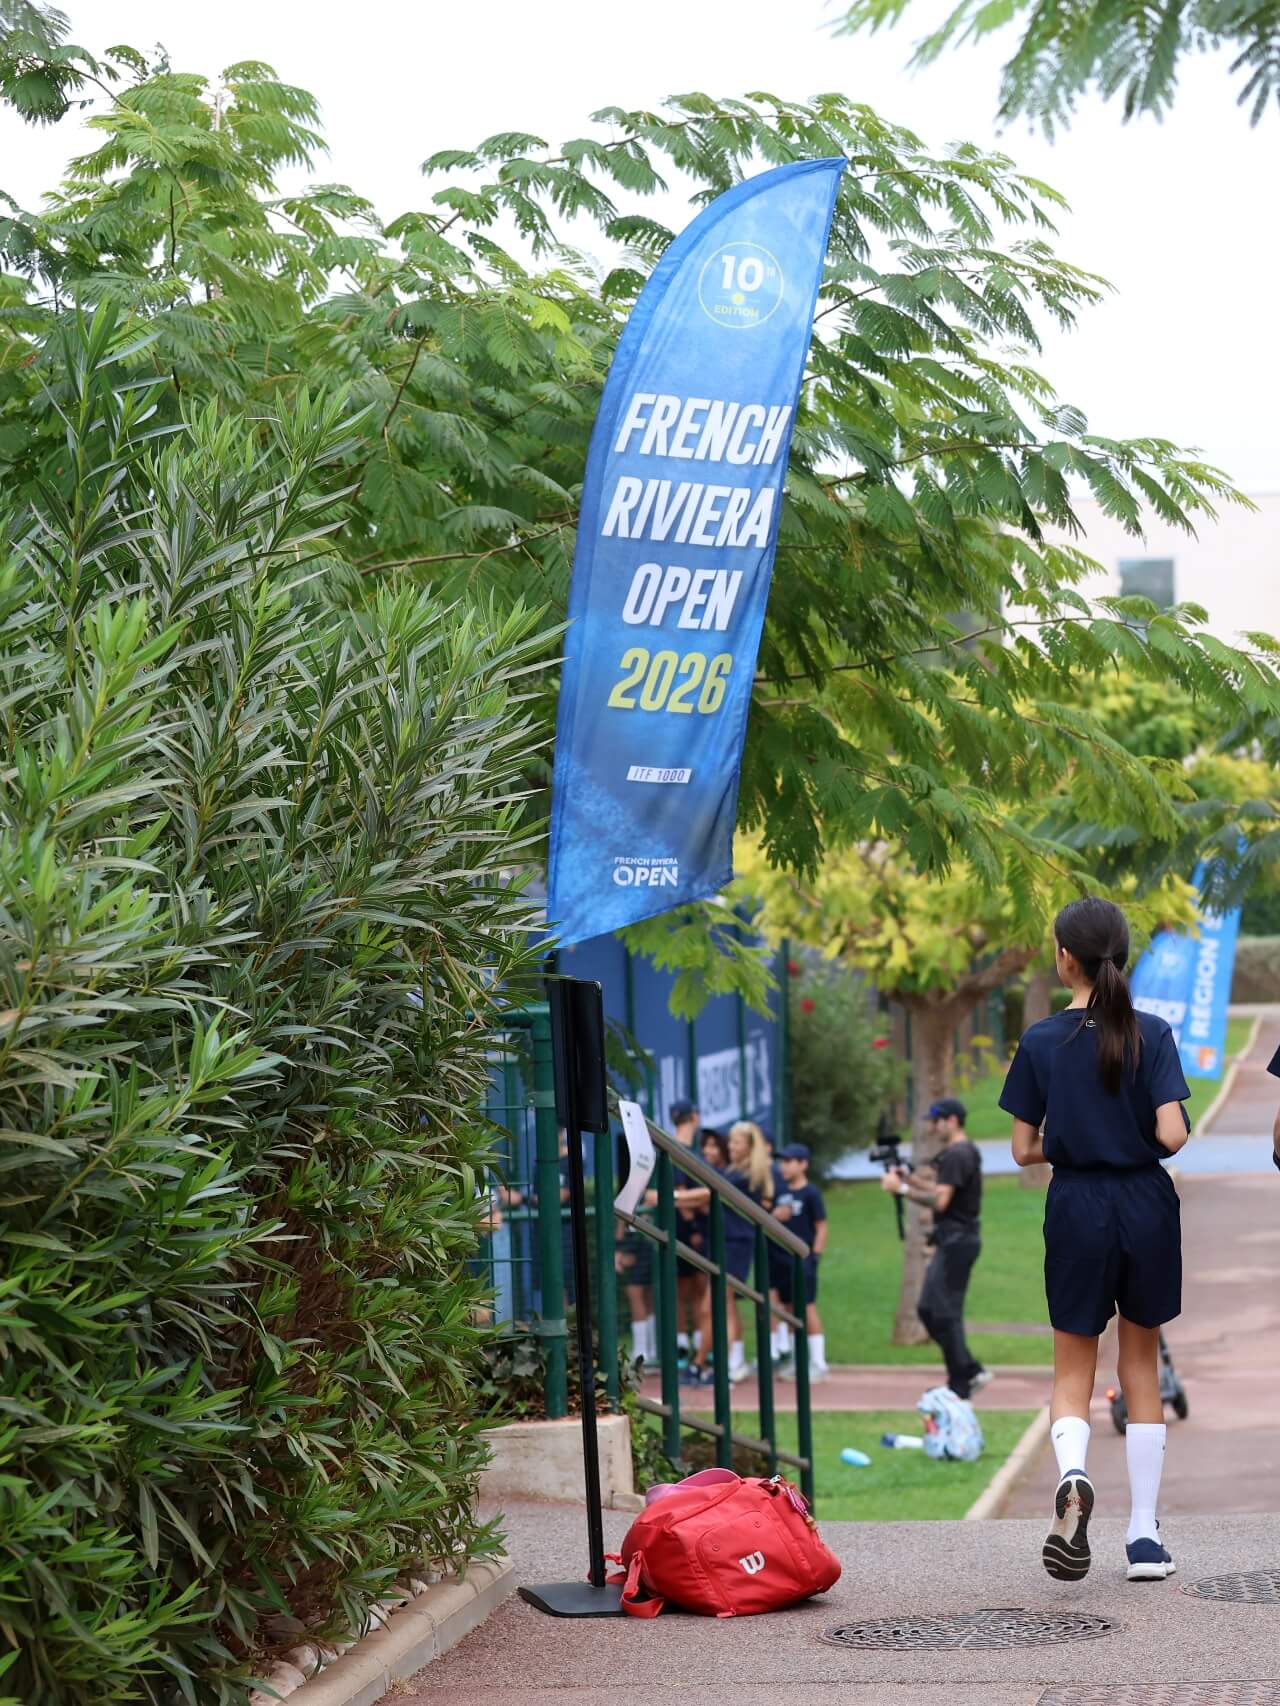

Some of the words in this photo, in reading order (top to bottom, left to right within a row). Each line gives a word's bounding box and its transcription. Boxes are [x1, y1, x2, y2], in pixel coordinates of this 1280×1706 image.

[714, 304, 760, 319] EDITION
[614, 392, 793, 466] FRENCH
[601, 476, 775, 549] RIVIERA
[622, 563, 743, 631] OPEN
[607, 647, 733, 715] 2026
[633, 767, 653, 780] ITF
[657, 769, 686, 782] 1000
[613, 865, 679, 887] OPEN
[614, 856, 650, 866] FRENCH
[651, 857, 678, 866] RIVIERA
